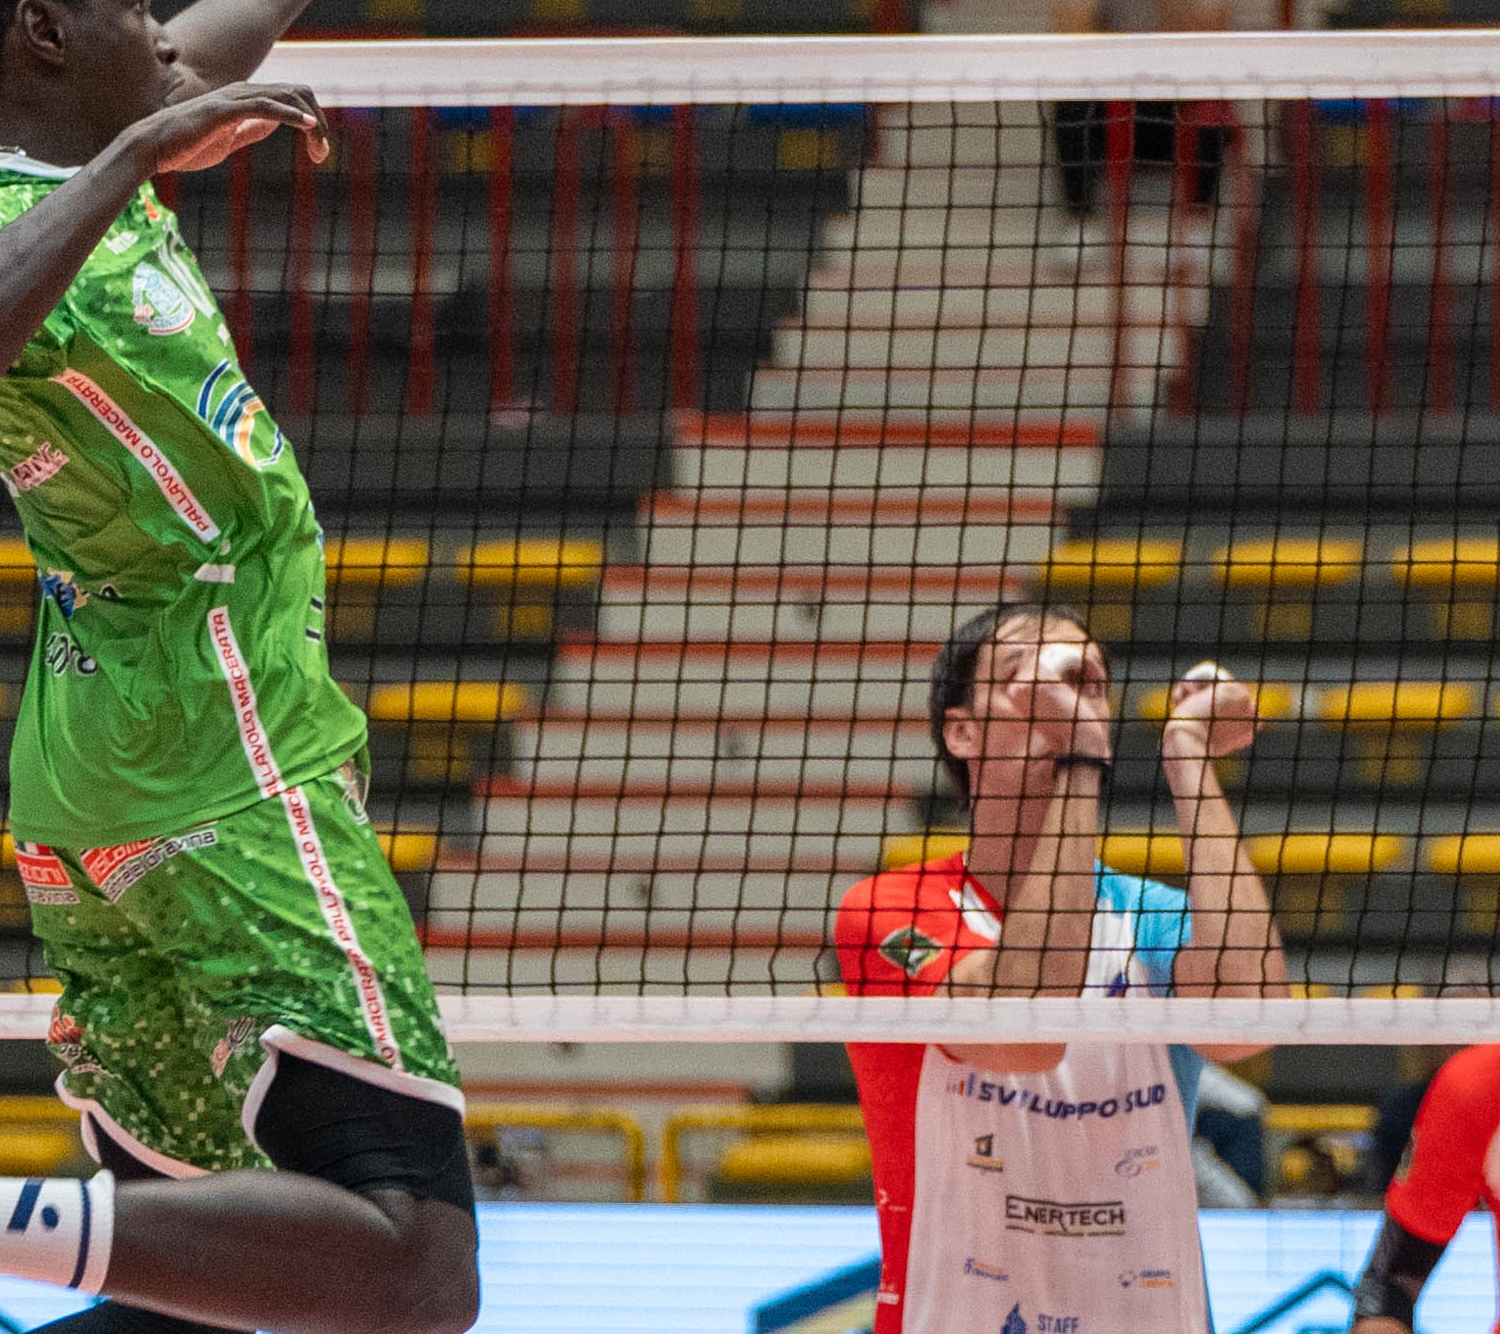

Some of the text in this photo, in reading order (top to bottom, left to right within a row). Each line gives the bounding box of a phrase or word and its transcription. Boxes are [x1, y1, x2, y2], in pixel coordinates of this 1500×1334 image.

[66, 375, 209, 532] PALLAVOLO MACERATA
[235, 710, 282, 797] ALLAVOLO
[978, 1081, 1167, 1119] SVILUPPO SUD
[1004, 1195, 1126, 1233] ENERTECH
